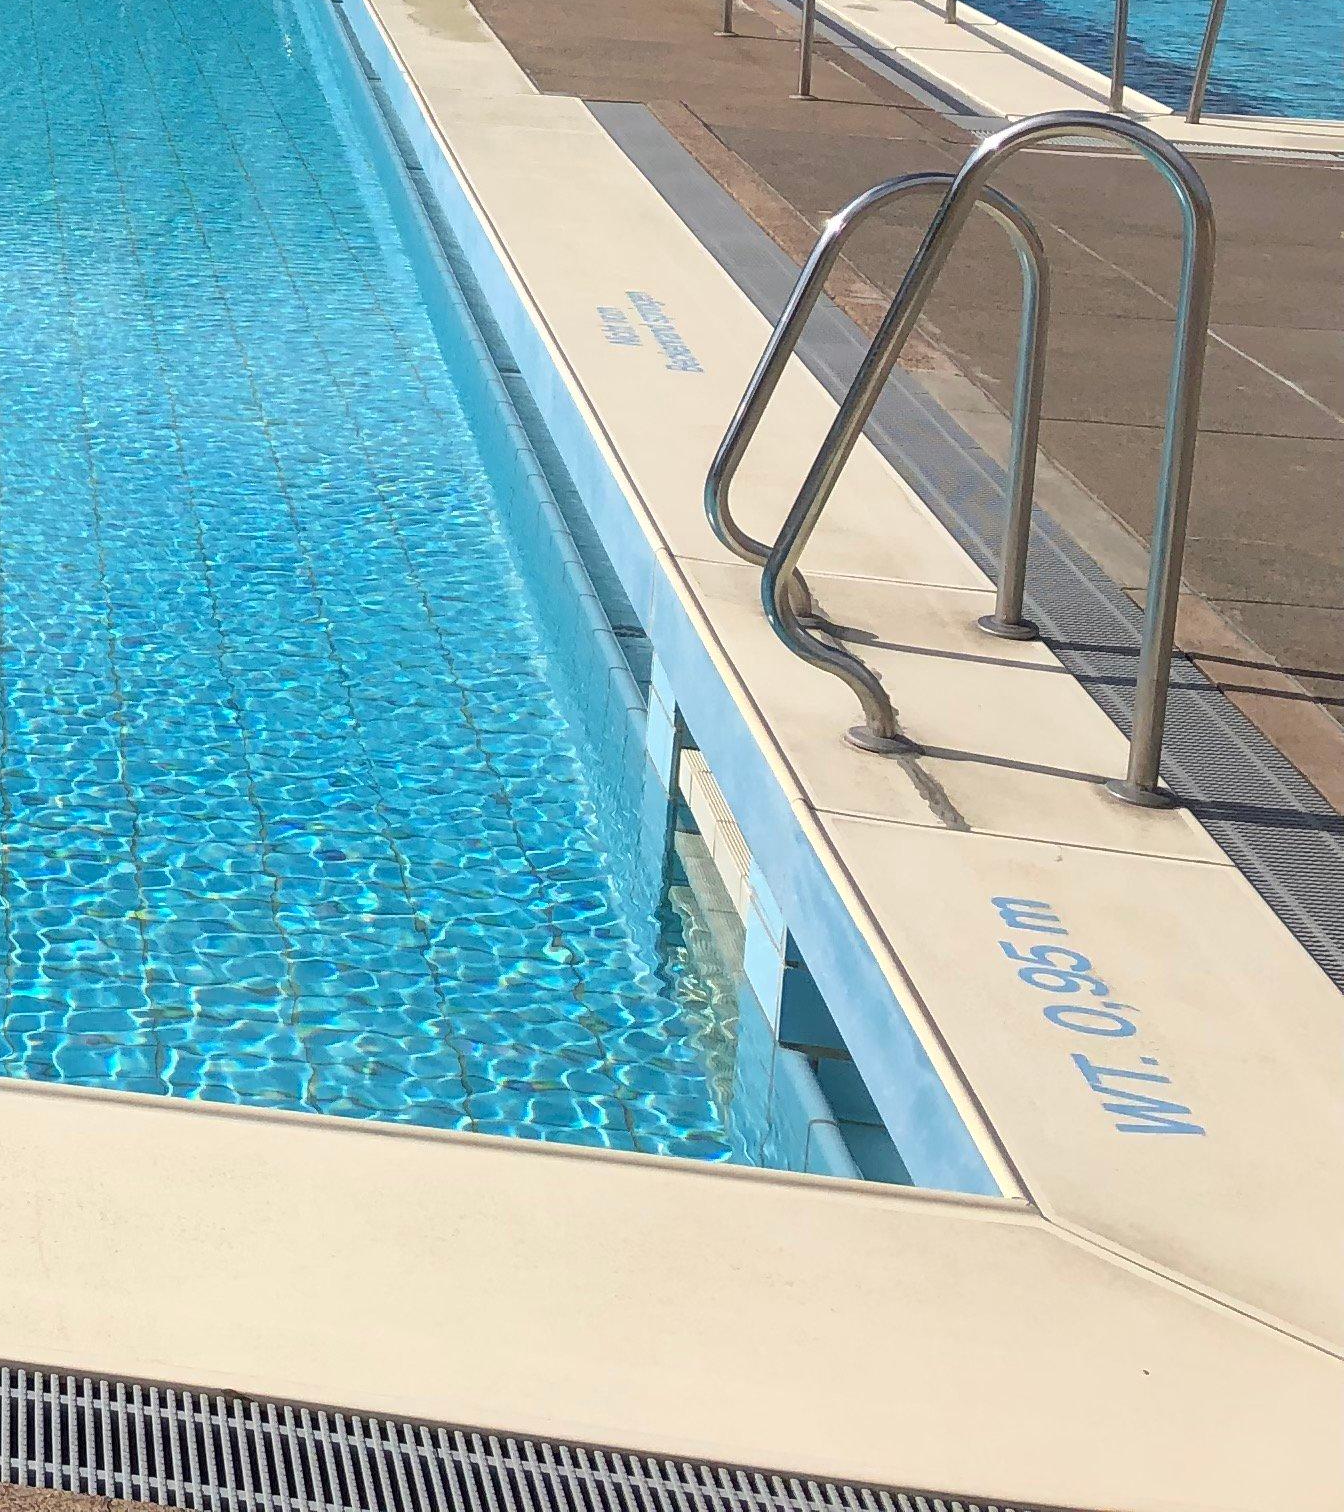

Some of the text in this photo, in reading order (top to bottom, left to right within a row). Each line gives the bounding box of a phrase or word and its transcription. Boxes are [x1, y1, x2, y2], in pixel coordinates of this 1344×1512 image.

[990, 895, 1206, 1137] WT. 0,95 m
